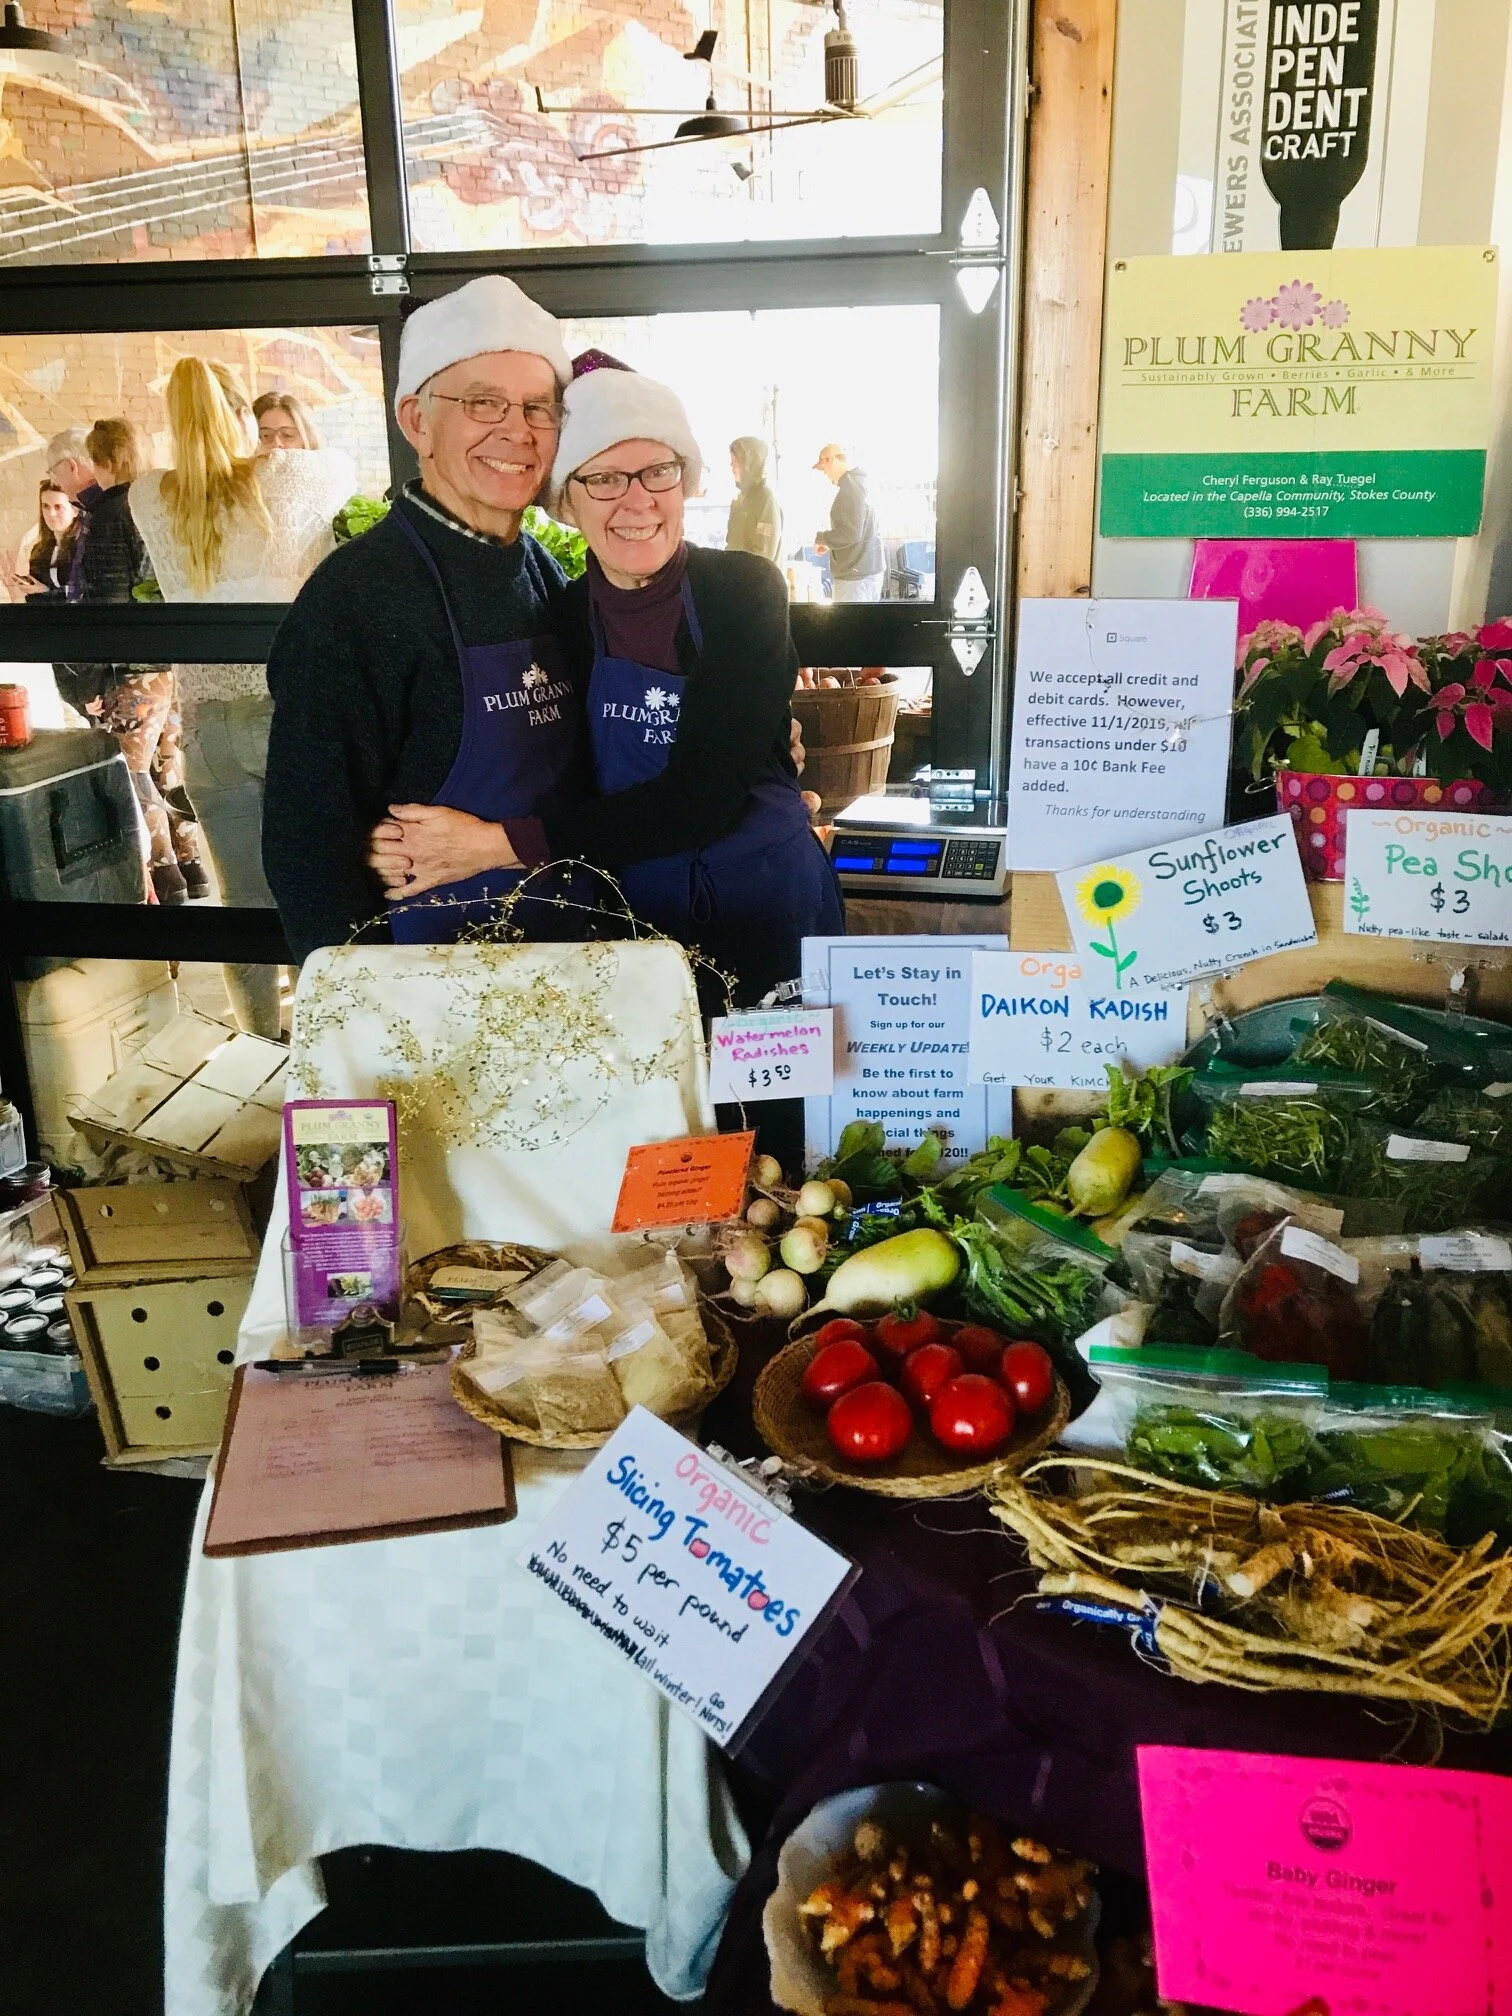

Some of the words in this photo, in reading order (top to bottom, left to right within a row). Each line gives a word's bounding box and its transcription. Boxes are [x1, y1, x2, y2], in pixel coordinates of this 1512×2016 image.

[1273, 2, 1361, 45] INDE
[1230, 0, 1258, 145] ASSOCIAT
[1270, 46, 1345, 89] PEN
[1267, 87, 1367, 131] DENT
[1263, 131, 1356, 160] CRAFT
[1123, 336, 1246, 366] PLUM
[1267, 328, 1479, 363] GRANNY
[1141, 372, 1216, 383] Sustainably
[1222, 371, 1264, 381] Grown
[1283, 370, 1329, 379] Berries
[1347, 368, 1386, 378] Garlic
[1406, 367, 1413, 376] &
[1421, 366, 1456, 376] More
[1231, 385, 1357, 418] FARM
[1202, 474, 1239, 487] Cheryl
[1242, 473, 1296, 486] Ferguson
[1300, 474, 1308, 484] &
[1312, 474, 1333, 487] Ray
[1336, 473, 1376, 487] Tuegel
[1143, 490, 1190, 502] Located
[1192, 491, 1204, 502] in
[1207, 491, 1226, 501] the
[1230, 490, 1272, 503] Capella
[1276, 489, 1345, 503] Community,
[1349, 488, 1389, 500] Stokes
[1392, 489, 1436, 502] County
[1244, 507, 1273, 518] (336)
[1276, 506, 1329, 517] 994-2517
[1119, 634, 1148, 644] Square
[1030, 671, 1052, 683] We
[1057, 673, 1103, 686] accept
[1106, 672, 1122, 684] all
[1127, 673, 1167, 686] credit
[1172, 674, 1198, 686] and
[483, 690, 531, 712] PLUM
[1028, 692, 1064, 704] debit
[1068, 693, 1109, 706] cards.
[1117, 694, 1185, 710] However,
[528, 704, 562, 726] FARM
[602, 703, 652, 723] PLUM
[1026, 714, 1087, 728] effective
[643, 728, 677, 745] FAR
[1025, 736, 1110, 750] transactions
[1114, 739, 1156, 751] under
[1160, 738, 1187, 754] $10
[1024, 757, 1056, 770] have
[1061, 761, 1068, 770] a
[1073, 759, 1098, 772] 10¢
[1102, 759, 1137, 773] Bank
[1141, 761, 1166, 774] Fee
[1022, 780, 1069, 793] added.
[1045, 804, 1088, 817] Thanks
[1090, 805, 1110, 819] for
[1113, 806, 1206, 824] understanding
[1148, 833, 1287, 880] Sunflower
[1385, 844, 1438, 876] Pea
[1183, 868, 1263, 905] Shoots
[1358, 924, 1383, 936] Nutty
[1389, 926, 1431, 938] pea-like
[1437, 929, 1461, 940] taste
[853, 966, 895, 980] Let's
[901, 966, 940, 983] Stay
[946, 966, 962, 980] in
[1020, 956, 1084, 990] Orga
[1130, 976, 1139, 988] A
[1194, 955, 1221, 971] Nutty
[1225, 947, 1260, 962] Crunch
[1262, 943, 1272, 952] in
[878, 993, 937, 1006] Touch!
[981, 993, 1069, 1019] DAIKON
[870, 1020, 892, 1030] Sign
[896, 1021, 908, 1030] up
[911, 1020, 925, 1029] for
[928, 1021, 945, 1029] our
[717, 1026, 821, 1047] Watermelon
[1040, 1026, 1073, 1054] $2
[1081, 1036, 1128, 1054] each
[732, 1043, 809, 1062] Radishes
[846, 1041, 907, 1054] WEEKLY
[862, 1068, 880, 1079] Be
[884, 1068, 905, 1079] the
[909, 1068, 936, 1079] first
[940, 1069, 954, 1079] to
[982, 1072, 1007, 1084] Get
[852, 1088, 888, 1099] know
[892, 1088, 930, 1099] about
[934, 1088, 964, 1099] farm
[856, 1107, 932, 1120] happenings
[936, 1107, 960, 1118] and
[674, 1453, 774, 1545] Organic
[606, 1455, 675, 1541] Slicing
[682, 1514, 801, 1637] Tomatoes
[601, 1516, 643, 1563] $5
[638, 1563, 680, 1589] per
[679, 1594, 750, 1644] pound
[547, 1540, 568, 1563] No
[572, 1564, 613, 1598] need
[612, 1593, 629, 1616] to
[633, 1616, 670, 1647] wait
[1062, 1599, 1124, 1622] Organically
[654, 1668, 703, 1714] winter!
[709, 1692, 725, 1710] Go
[1265, 1860, 1319, 1887] Baby
[1325, 1869, 1396, 1897] Ginger
